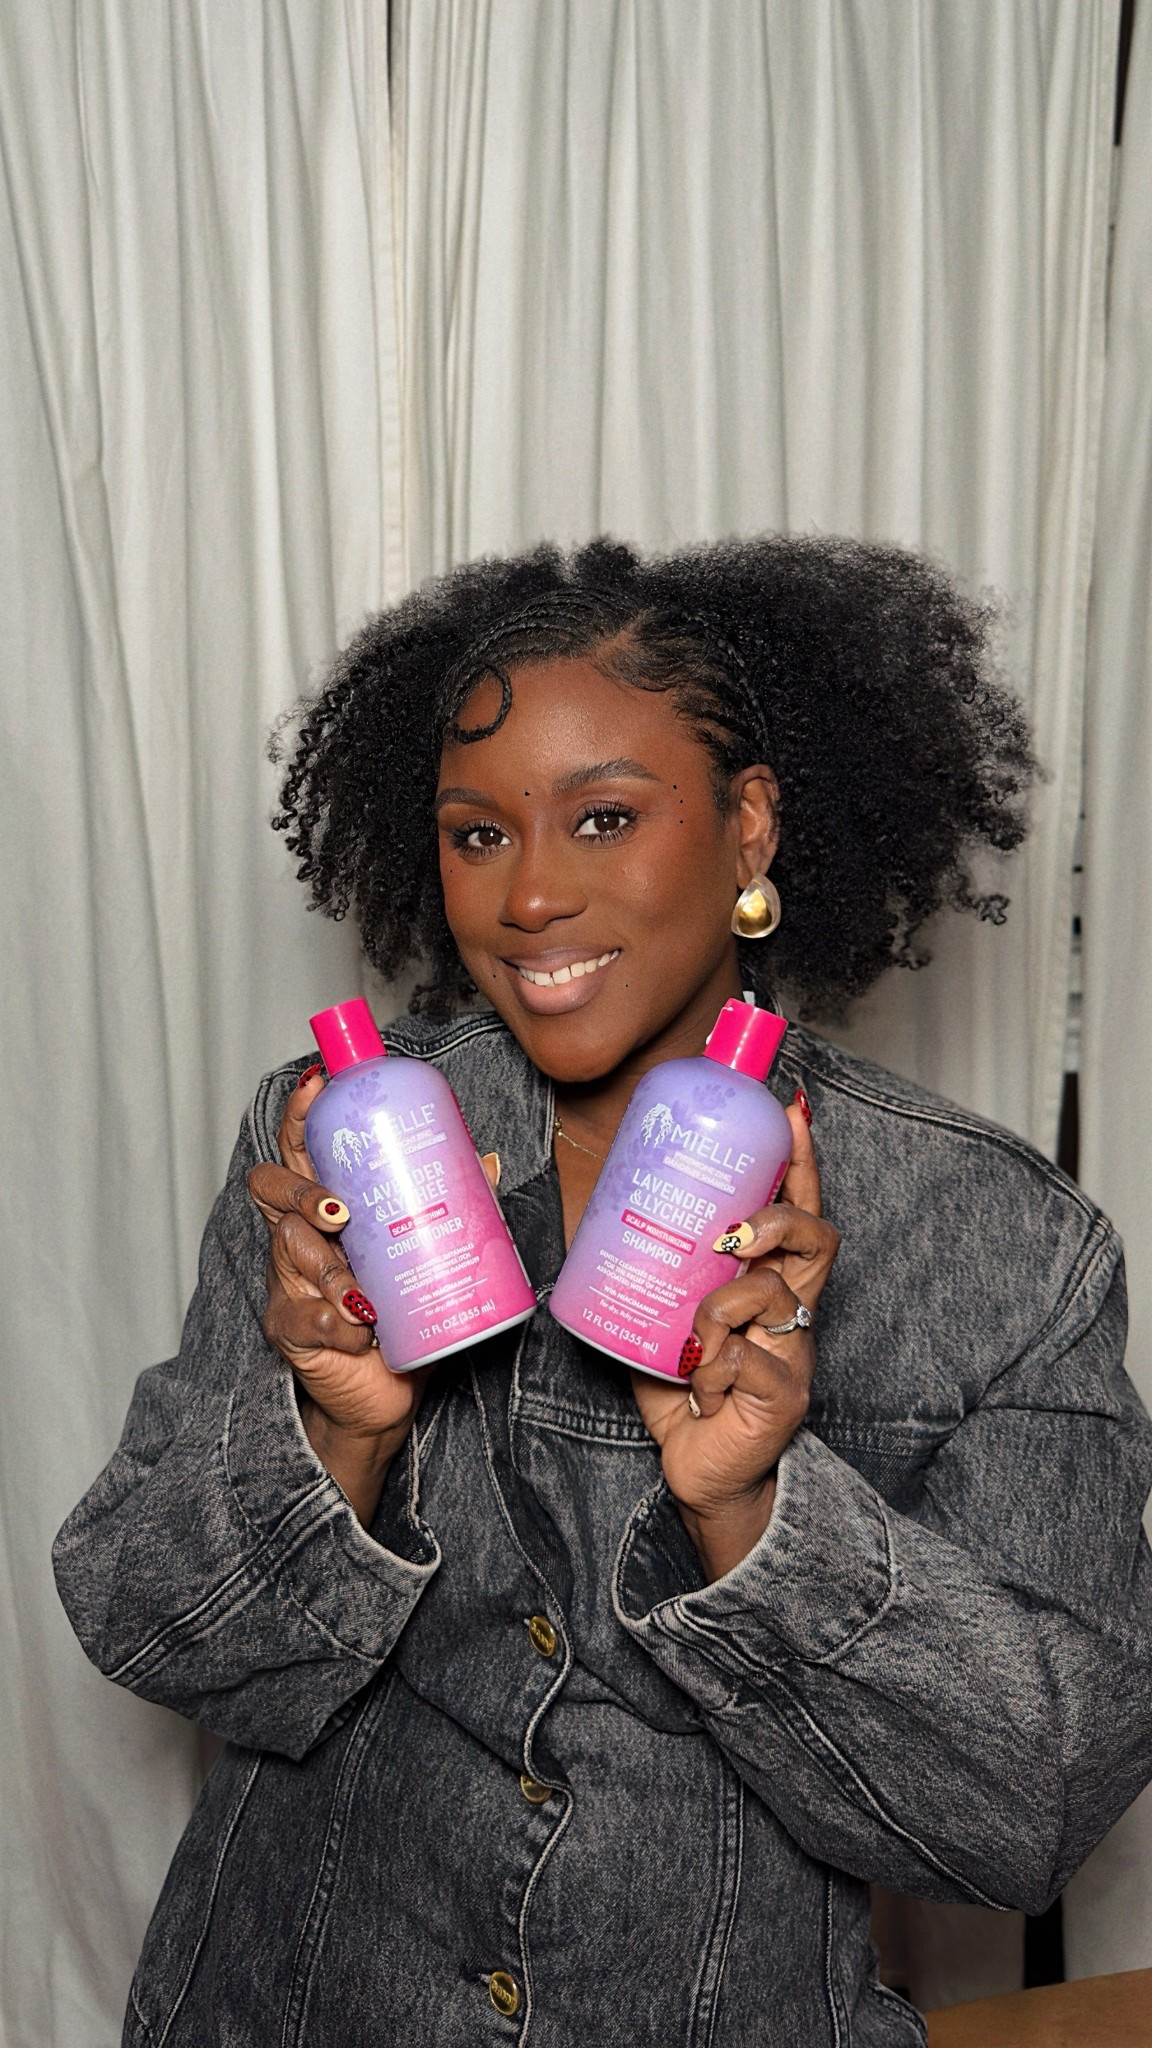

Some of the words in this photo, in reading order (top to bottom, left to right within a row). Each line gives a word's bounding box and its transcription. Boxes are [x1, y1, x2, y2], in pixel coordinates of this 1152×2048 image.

[360, 1105, 435, 1149] MELLE
[363, 1161, 445, 1207] LAVEDER
[375, 1179, 448, 1222] &LYHEE
[632, 1168, 717, 1220] LAVENDER
[387, 1217, 464, 1259] CONDONER
[392, 1221, 413, 1236] SCALP
[626, 1215, 645, 1229] SCALP
[646, 1224, 692, 1251] MOISTURIZING
[404, 1274, 417, 1286] HAIR
[459, 1252, 471, 1261] ITCH
[622, 1231, 682, 1268] SHAMPOO
[395, 1268, 415, 1282] GENTLY
[400, 1276, 433, 1296] ASSOCIATED
[450, 1256, 480, 1273] DANDRUFF
[597, 1265, 630, 1286] ASSOCIATED
[630, 1283, 646, 1295] WITH
[647, 1290, 679, 1308] DANDRUFF
[600, 1250, 618, 1262] GENTLY
[619, 1258, 647, 1278] CLEANSES
[648, 1272, 667, 1288] SCALP
[673, 1286, 688, 1296] HAIR
[604, 1261, 616, 1270] FOR
[616, 1266, 626, 1275] THE
[626, 1271, 645, 1285] RELIEF
[645, 1280, 654, 1289] OF
[655, 1286, 676, 1300] FLAKES
[420, 1329, 431, 1340] 12
[432, 1325, 442, 1334] FL
[443, 1318, 459, 1330] OZ
[459, 1307, 480, 1324] (355
[481, 1299, 495, 1312] mL)
[604, 1285, 617, 1296] With
[618, 1292, 659, 1317] NIACINAMIDE
[620, 1309, 633, 1322] itchy
[583, 1308, 593, 1321] 12
[593, 1312, 602, 1326] FL
[604, 1321, 618, 1336] OZ
[619, 1328, 642, 1345] (355
[643, 1340, 659, 1354] mL)
